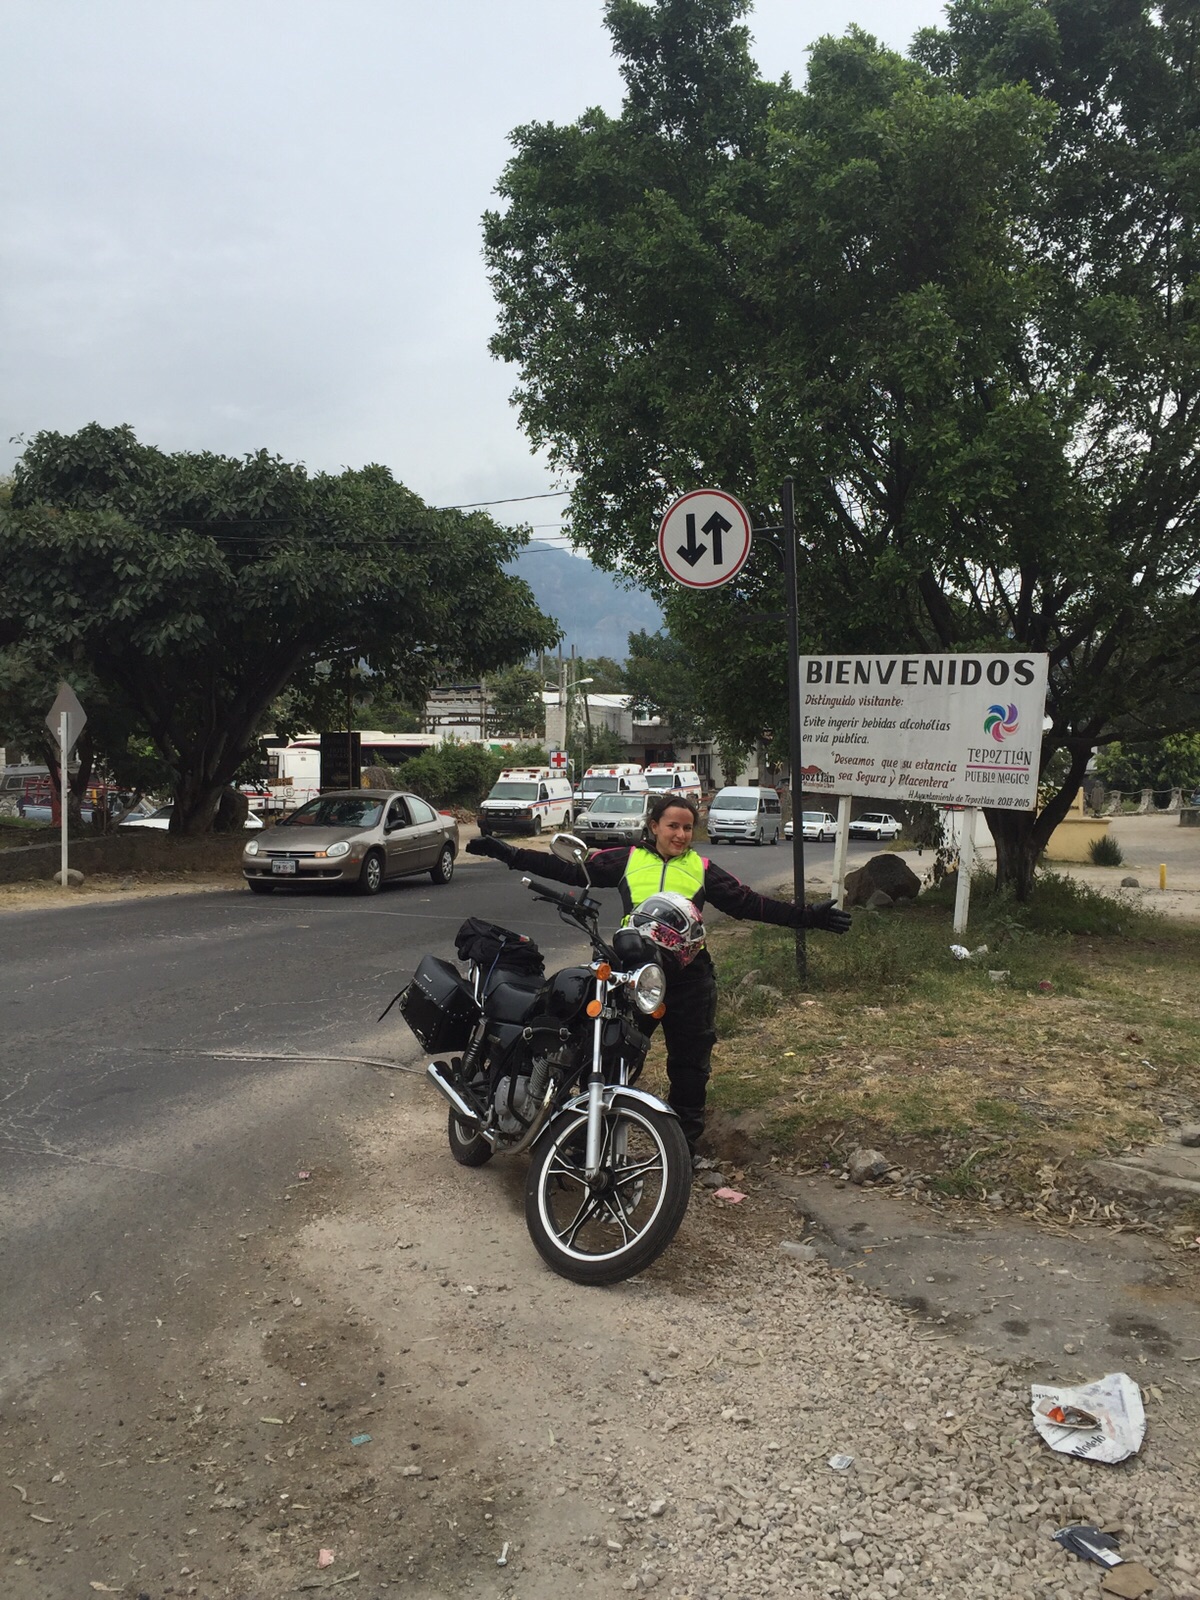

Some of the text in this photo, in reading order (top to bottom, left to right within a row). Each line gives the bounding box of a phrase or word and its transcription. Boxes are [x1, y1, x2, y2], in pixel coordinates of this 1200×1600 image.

[806, 659, 1035, 686] BIENVENIDOS
[805, 694, 904, 709] Distinguido visitante:
[803, 715, 826, 727] Evite
[828, 717, 860, 731] ingerir
[862, 717, 897, 729] bebidas
[802, 733, 813, 742] en
[881, 759, 899, 769] que
[902, 760, 912, 769] su
[915, 758, 957, 773] estancia
[838, 771, 853, 781] sea
[856, 770, 886, 786] Segura
[955, 794, 963, 802] de
[997, 796, 1030, 808] 2013-2015
